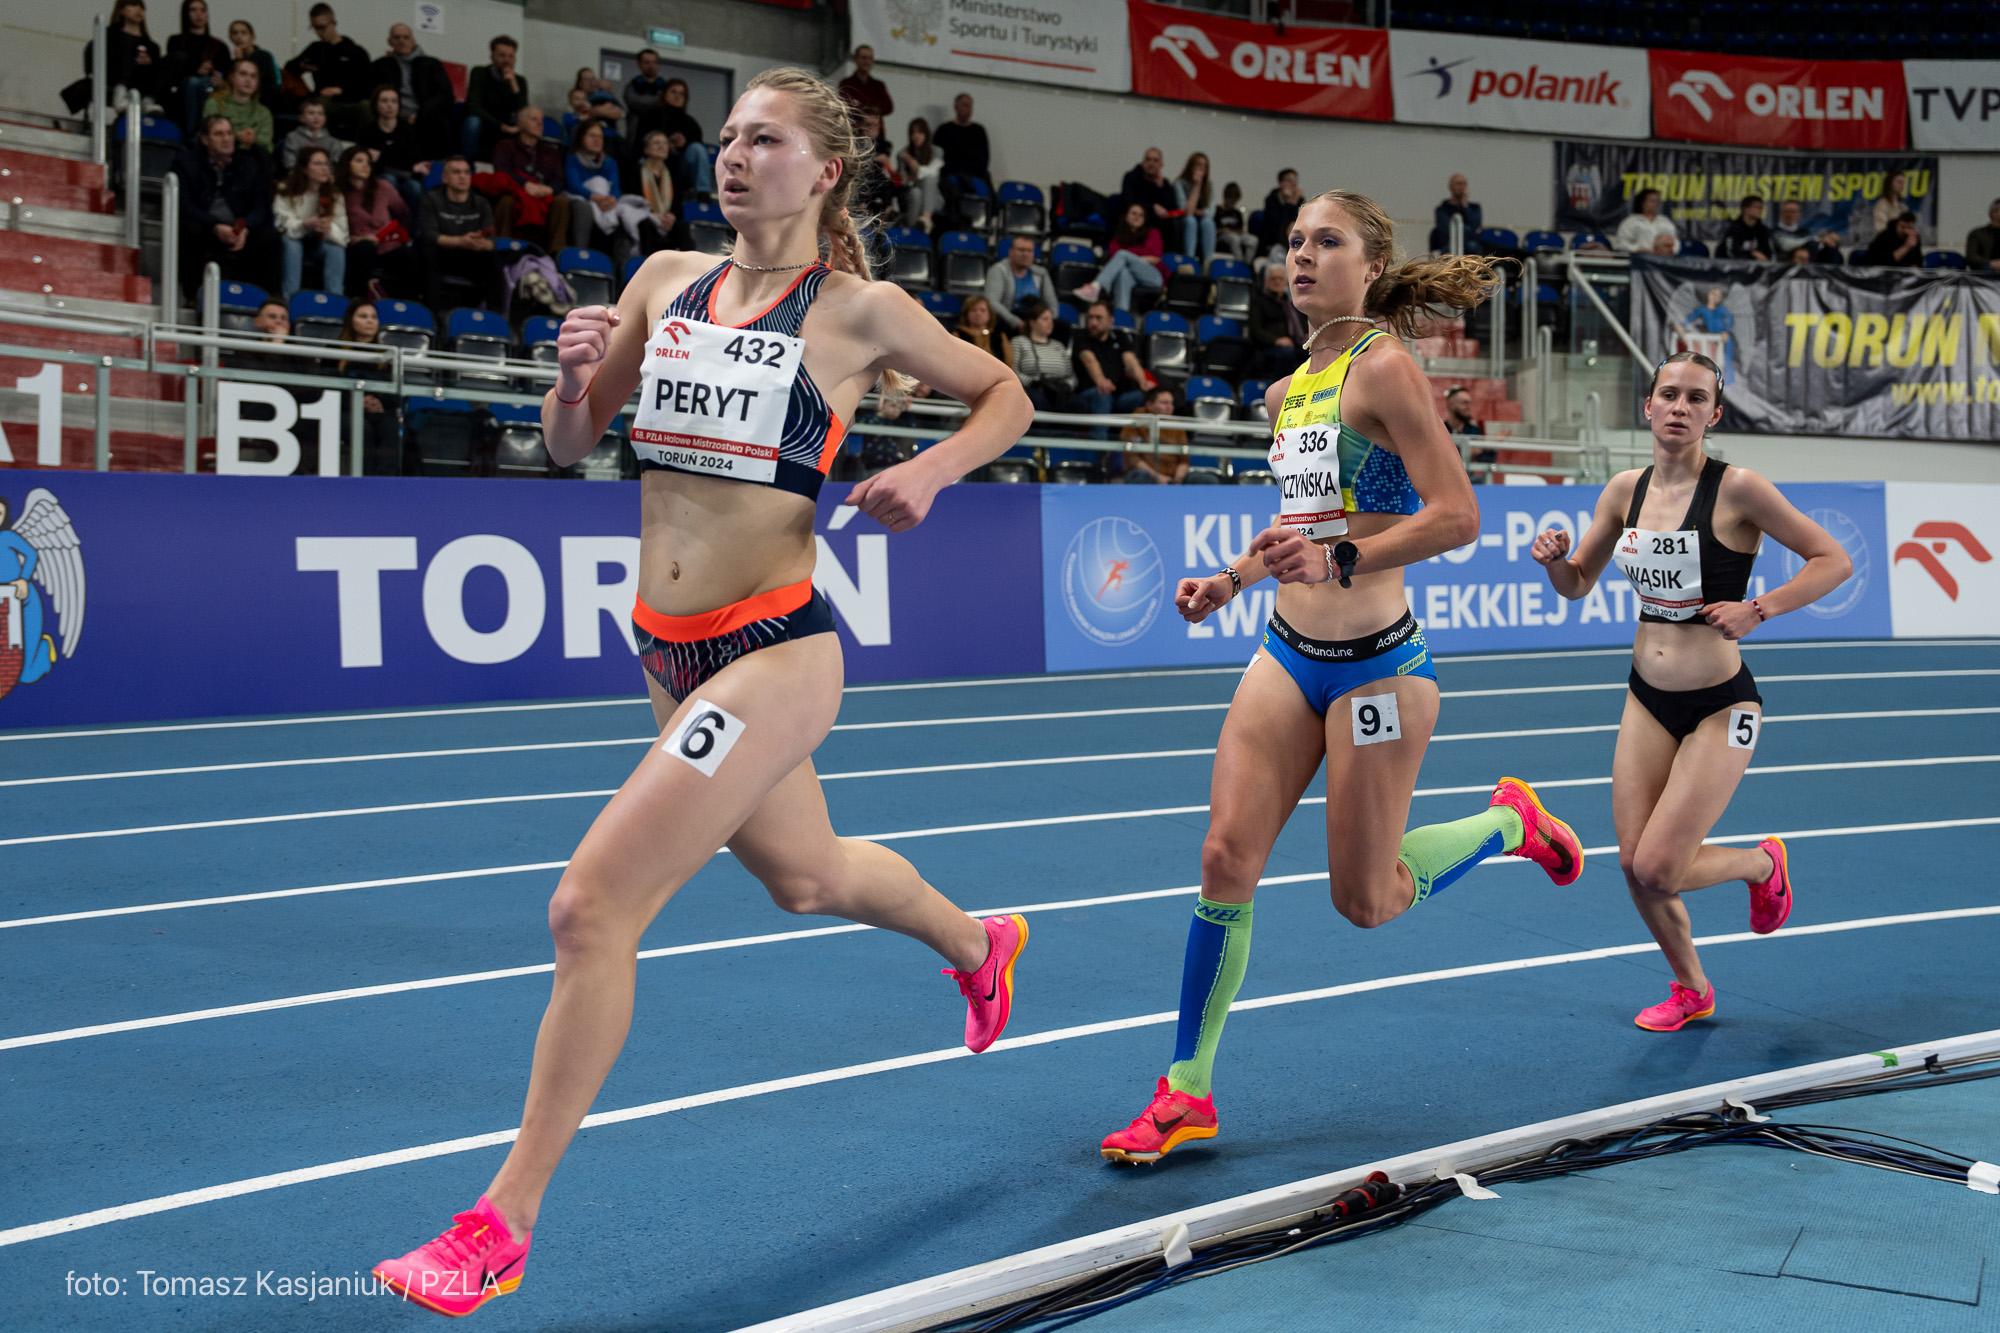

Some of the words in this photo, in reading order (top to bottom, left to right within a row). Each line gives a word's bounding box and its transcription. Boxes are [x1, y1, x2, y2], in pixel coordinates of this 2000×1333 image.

[950, 16, 1009, 40] Sportu
[1012, 24, 1018, 43] i
[1021, 26, 1099, 54] Turystyki
[1231, 42, 1371, 89] ORLEN
[1468, 64, 1622, 107] polanik
[1745, 82, 1884, 121] ORLEN
[1912, 86, 2000, 122] TVP
[1710, 173, 1825, 202] MIASTEM
[1827, 168, 1930, 202] SPOTU
[1785, 299, 1962, 369] TORUŃ
[655, 347, 690, 361] ORLEN
[723, 335, 786, 369] 432
[655, 378, 758, 422] PERYT
[216, 381, 341, 478] B1
[635, 430, 646, 440] 68.
[646, 433, 663, 442] PZLA
[664, 434, 691, 446] Halowe
[692, 438, 743, 453] Mistrzostwa
[744, 446, 774, 458] Polski
[1299, 430, 1328, 454] 336
[658, 450, 697, 466] TORUŃ
[700, 455, 733, 471] 2024
[1318, 510, 1341, 521] Polski
[1652, 537, 1689, 555] 281
[296, 504, 892, 669] TORŃ
[1625, 564, 1683, 592] WĄSIK
[1642, 604, 1660, 615] ORUŃ
[1660, 608, 1679, 618] 2024
[680, 710, 726, 760] 6
[1358, 704, 1393, 736] 9.
[1736, 713, 1754, 746] 5
